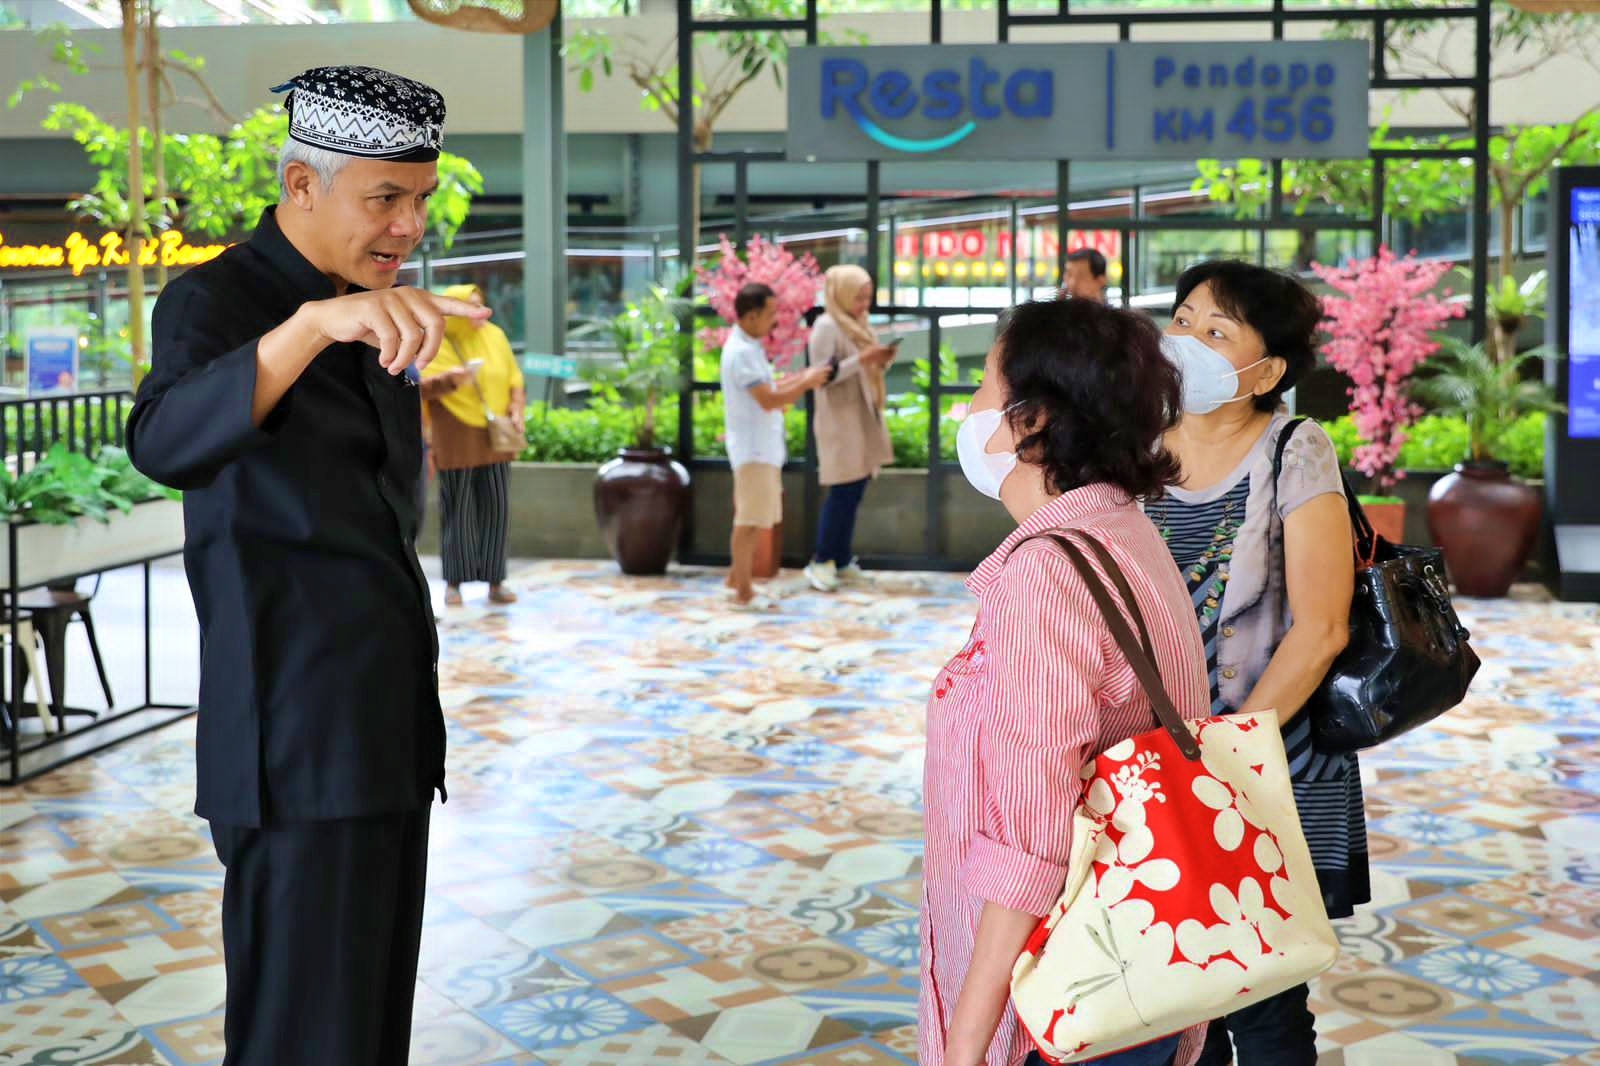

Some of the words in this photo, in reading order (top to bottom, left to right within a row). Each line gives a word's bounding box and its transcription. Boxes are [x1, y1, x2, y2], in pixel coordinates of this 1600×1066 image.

[821, 57, 1053, 120] Resta
[1154, 56, 1335, 93] Pendopo
[1154, 107, 1214, 144] KM
[1226, 96, 1335, 144] 456
